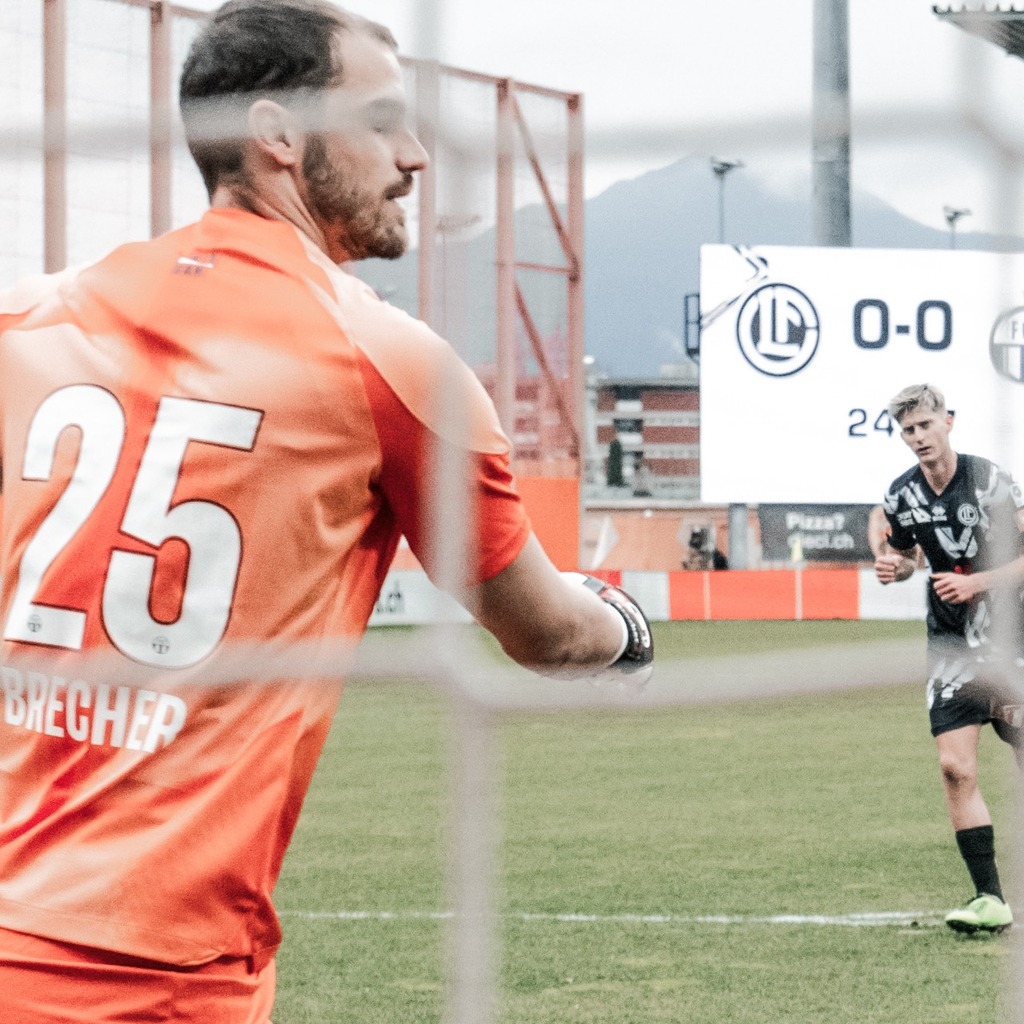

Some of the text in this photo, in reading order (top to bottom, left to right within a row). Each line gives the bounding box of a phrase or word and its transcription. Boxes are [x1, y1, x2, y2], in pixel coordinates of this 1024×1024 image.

[853, 298, 952, 351] 0-0
[847, 408, 895, 438] 24
[4, 382, 265, 669] 25
[0, 666, 188, 754] BRECHER
